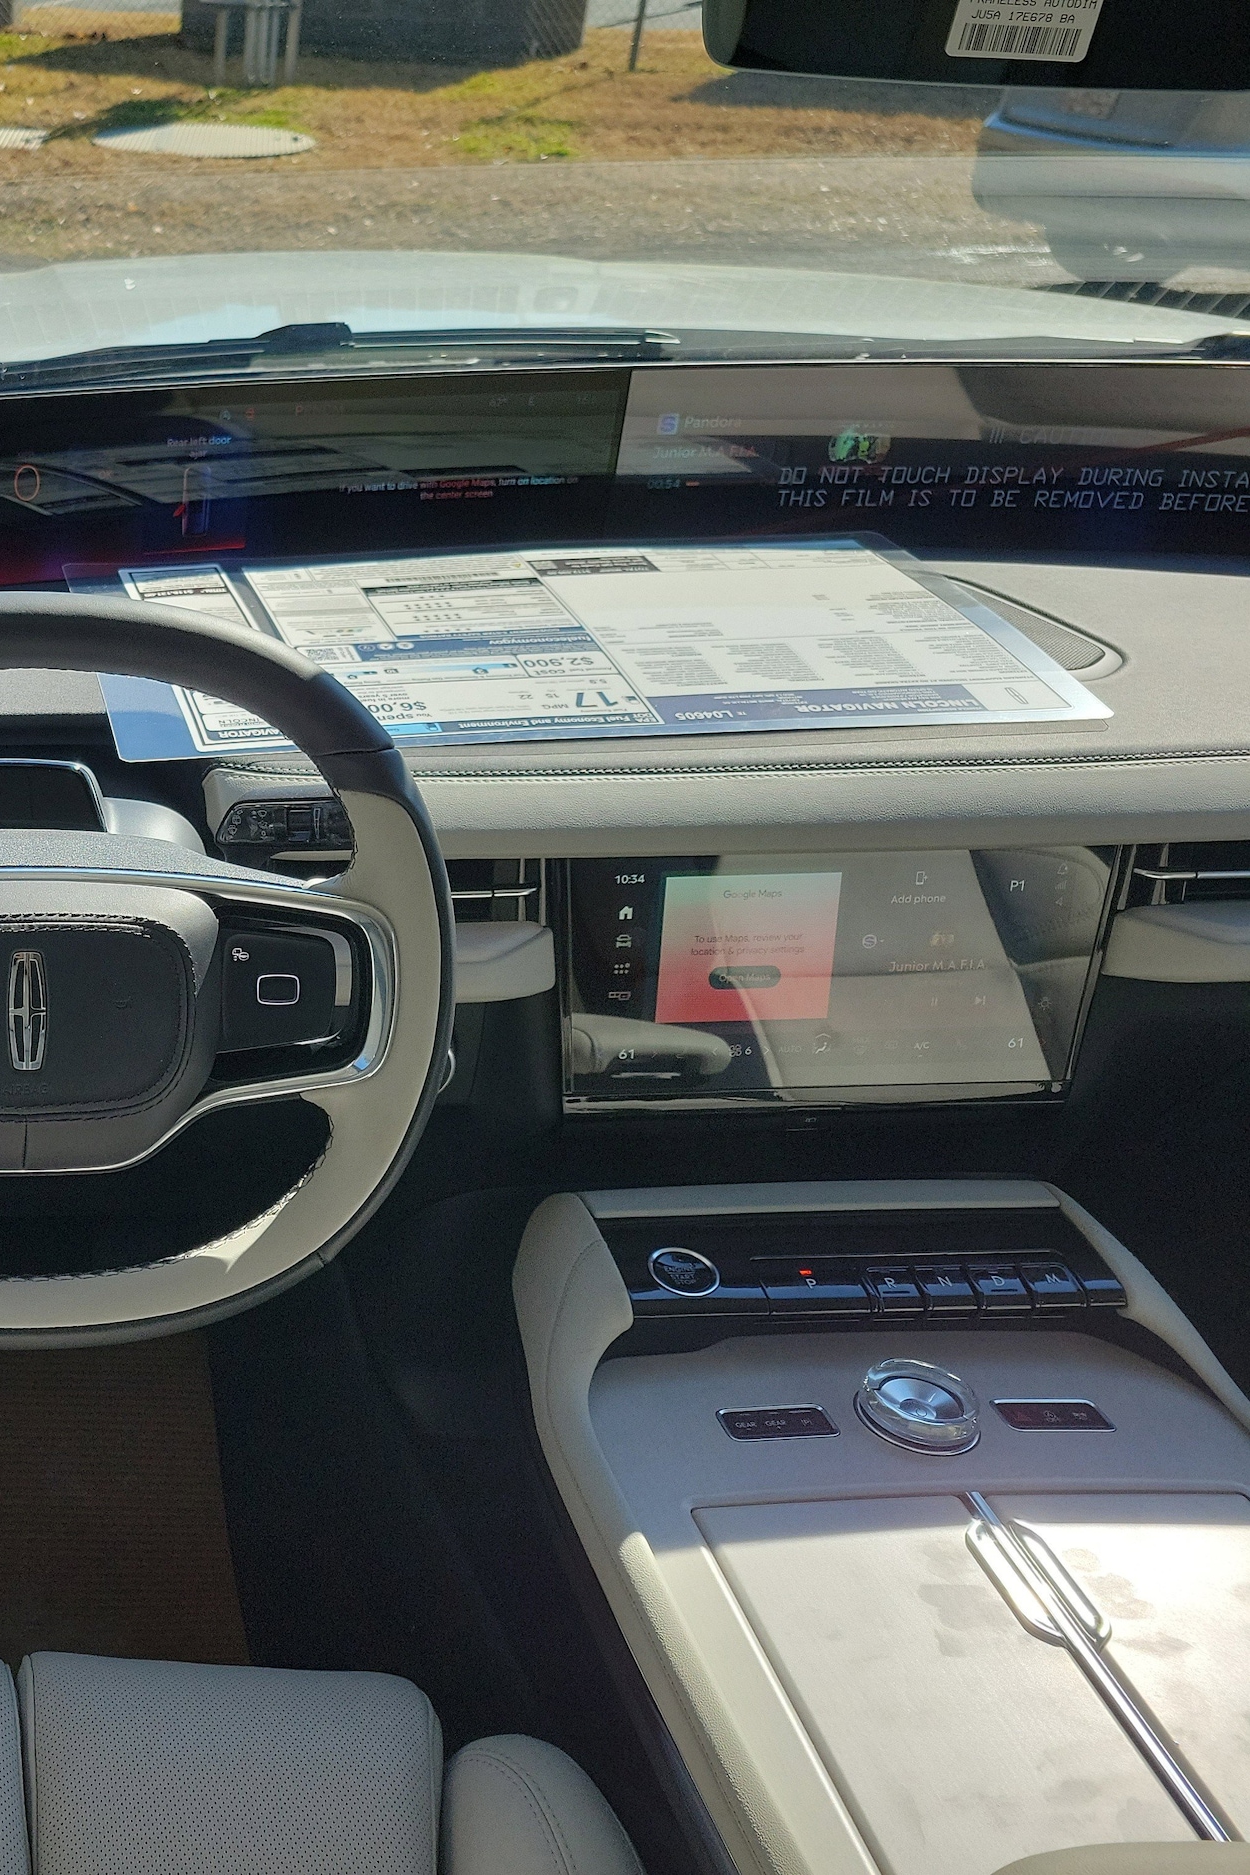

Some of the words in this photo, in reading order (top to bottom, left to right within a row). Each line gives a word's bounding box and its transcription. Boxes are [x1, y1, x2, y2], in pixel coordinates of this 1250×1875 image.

[1044, 0, 1097, 10] AUTODIM
[971, 10, 1001, 20] JU5A
[1008, 11, 1052, 22] 17E678
[1060, 13, 1075, 23] BA
[684, 415, 742, 428] Pandora
[167, 438, 188, 447] Rear
[190, 436, 207, 446] left
[208, 435, 232, 445] door
[189, 450, 208, 460] ajar
[652, 446, 696, 459] Junior
[778, 467, 808, 485] DO
[821, 467, 865, 485] NOT
[881, 467, 950, 485] TOUCH
[965, 467, 1064, 486] DISPLAY
[1078, 467, 1164, 487] DURING
[364, 483, 385, 492] want
[387, 482, 396, 491] to
[398, 481, 418, 490] drive
[420, 480, 438, 489] with
[440, 480, 470, 489] Google
[518, 478, 529, 486] on
[531, 477, 565, 486] location
[420, 491, 434, 500] the
[436, 490, 461, 500] center
[464, 490, 494, 499] screen
[778, 489, 826, 507] THIS
[841, 489, 895, 507] FILM
[908, 489, 933, 507] IS
[950, 489, 977, 508] TO
[990, 490, 1020, 508] BE
[1034, 490, 1145, 510] REMOVED
[1159, 492, 1250, 513] BEFORE
[523, 656, 594, 669] $2,900
[575, 691, 618, 709] 17
[900, 699, 979, 710] LINCOLN
[367, 700, 426, 713] $6,00
[794, 701, 899, 713] NAVIGATOR
[376, 712, 413, 722] spen
[554, 714, 604, 725] Economy
[607, 714, 630, 723] Fuel
[674, 708, 734, 722] L04605
[458, 719, 529, 731] Environment
[531, 718, 551, 726] and
[218, 727, 283, 739] AVIGATOR
[614, 873, 646, 886] 10:34
[1009, 879, 1026, 893] P1
[723, 889, 757, 901] Google
[758, 889, 783, 900] Maps
[891, 893, 913, 905] Add
[915, 893, 947, 906] phone
[694, 934, 705, 944] To
[707, 935, 722, 944] use
[753, 933, 782, 942] review
[783, 933, 804, 944] your
[691, 945, 725, 957] location
[727, 946, 734, 956] &
[736, 945, 769, 959] privacy
[770, 944, 805, 957] settings
[888, 960, 930, 973] Junior
[719, 974, 745, 985] Open
[746, 973, 772, 984] Maps
[618, 1049, 636, 1061] 61
[744, 1045, 752, 1056] 6
[913, 1040, 930, 1051] A/C
[1007, 1037, 1025, 1049] 61
[663, 1265, 696, 1273] ENGINE
[806, 1277, 818, 1290] P
[884, 1276, 897, 1289] R
[938, 1275, 953, 1288] N
[992, 1275, 1006, 1287] D
[1044, 1273, 1061, 1285] M
[735, 1421, 758, 1429] GEAR
[764, 1419, 786, 1427] GEAR
